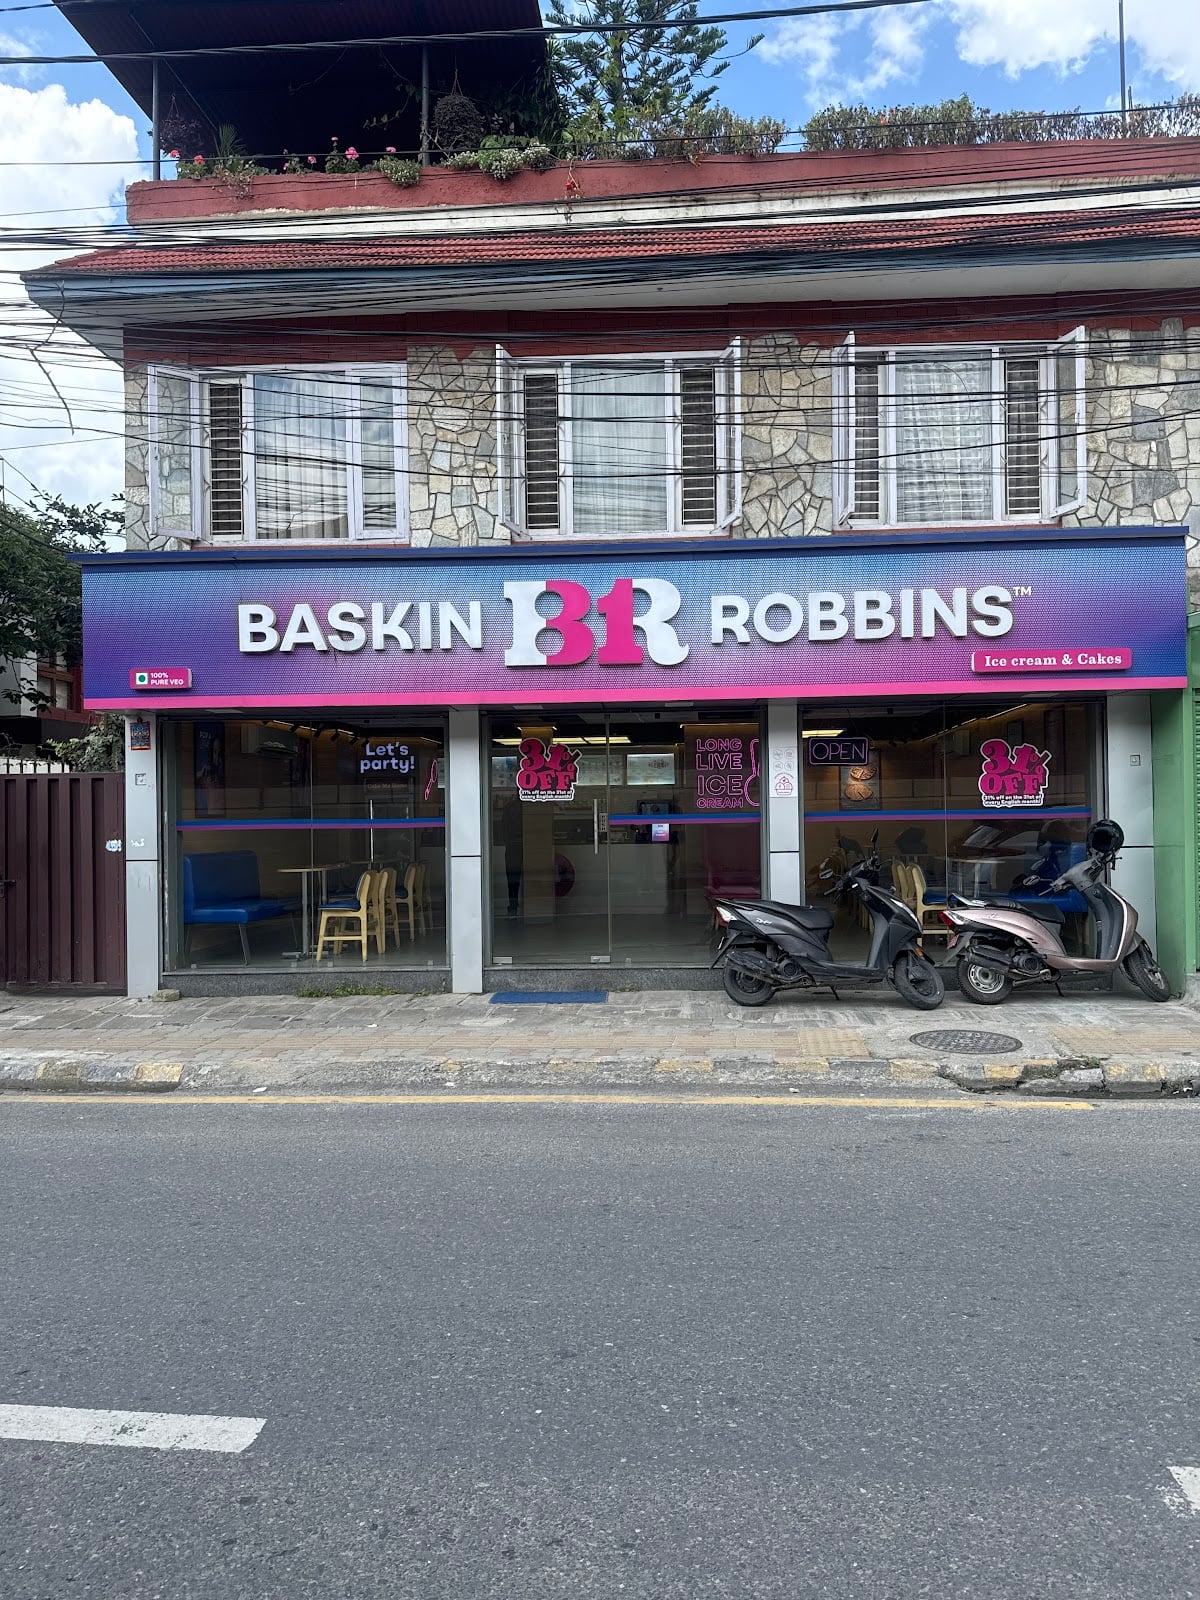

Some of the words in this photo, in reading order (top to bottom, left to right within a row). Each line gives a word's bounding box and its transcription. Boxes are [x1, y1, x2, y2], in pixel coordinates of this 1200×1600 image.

[237, 600, 483, 652] BASKIN
[710, 585, 1014, 645] ROBBINS
[985, 655, 1007, 667] Ice
[1011, 656, 1057, 666] cream
[1061, 653, 1073, 665] &
[1077, 652, 1122, 665] Cakes
[365, 742, 409, 756] Let's
[696, 738, 743, 752] LONG
[812, 742, 865, 760] OPEN
[360, 755, 415, 774] party!
[519, 738, 582, 772] 31%
[695, 752, 743, 771] LIVE
[981, 740, 1052, 774] 31%
[517, 769, 575, 790] OFF
[697, 774, 744, 796] ICE
[980, 772, 1044, 795] OFF
[696, 797, 744, 809] CREAM
